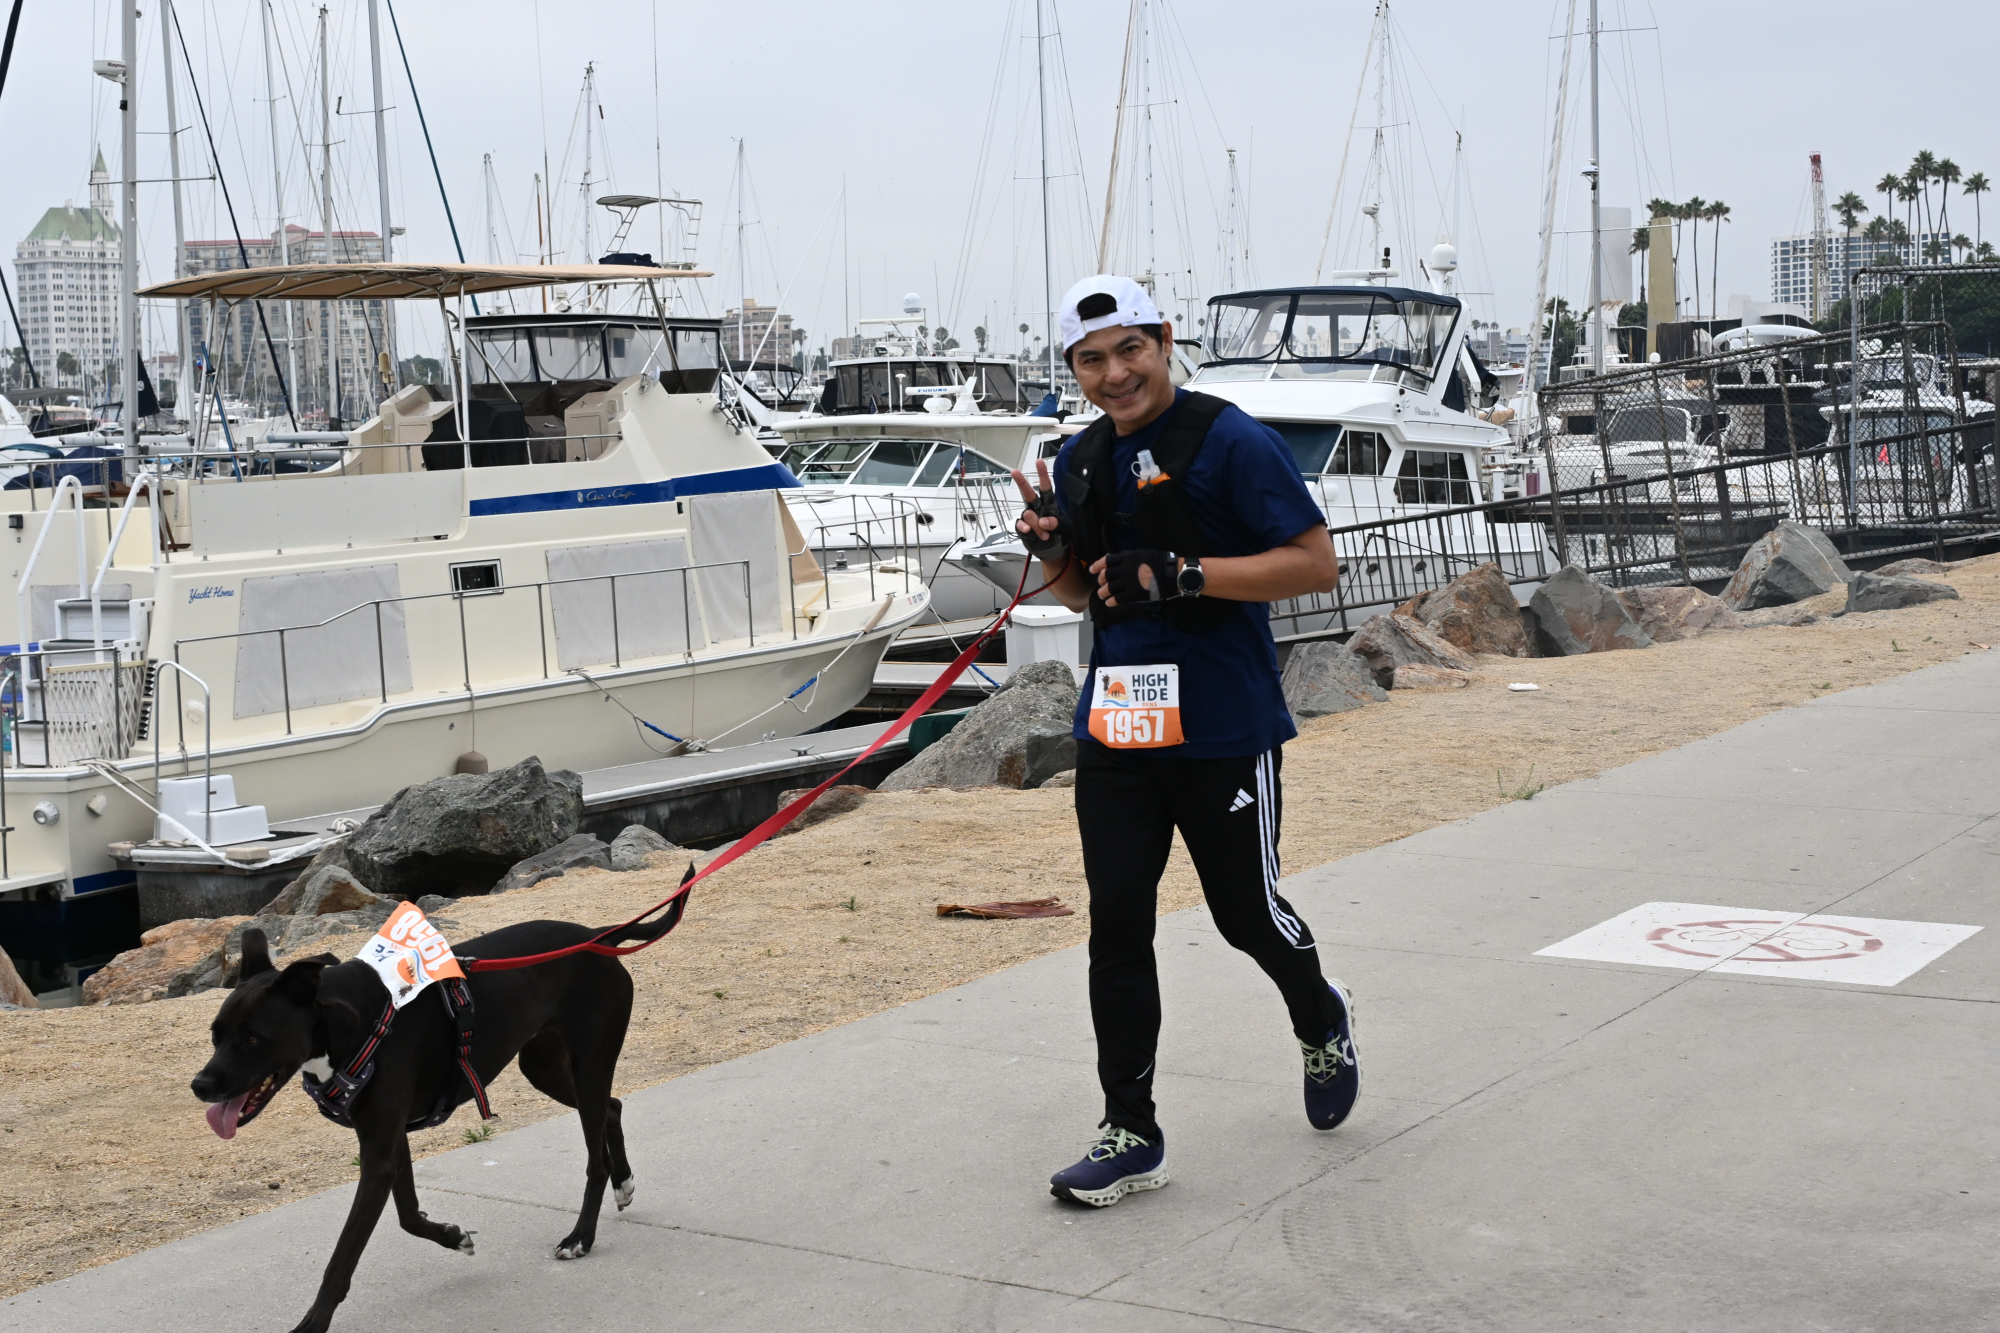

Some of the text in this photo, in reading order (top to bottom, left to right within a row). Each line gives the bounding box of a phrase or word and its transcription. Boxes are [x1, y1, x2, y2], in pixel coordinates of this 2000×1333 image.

[188, 585, 235, 604] Yacht Home
[1131, 673, 1168, 687] HIGH
[1132, 688, 1168, 702] TIDE
[1102, 709, 1165, 743] 1957
[389, 911, 455, 971] 1958
